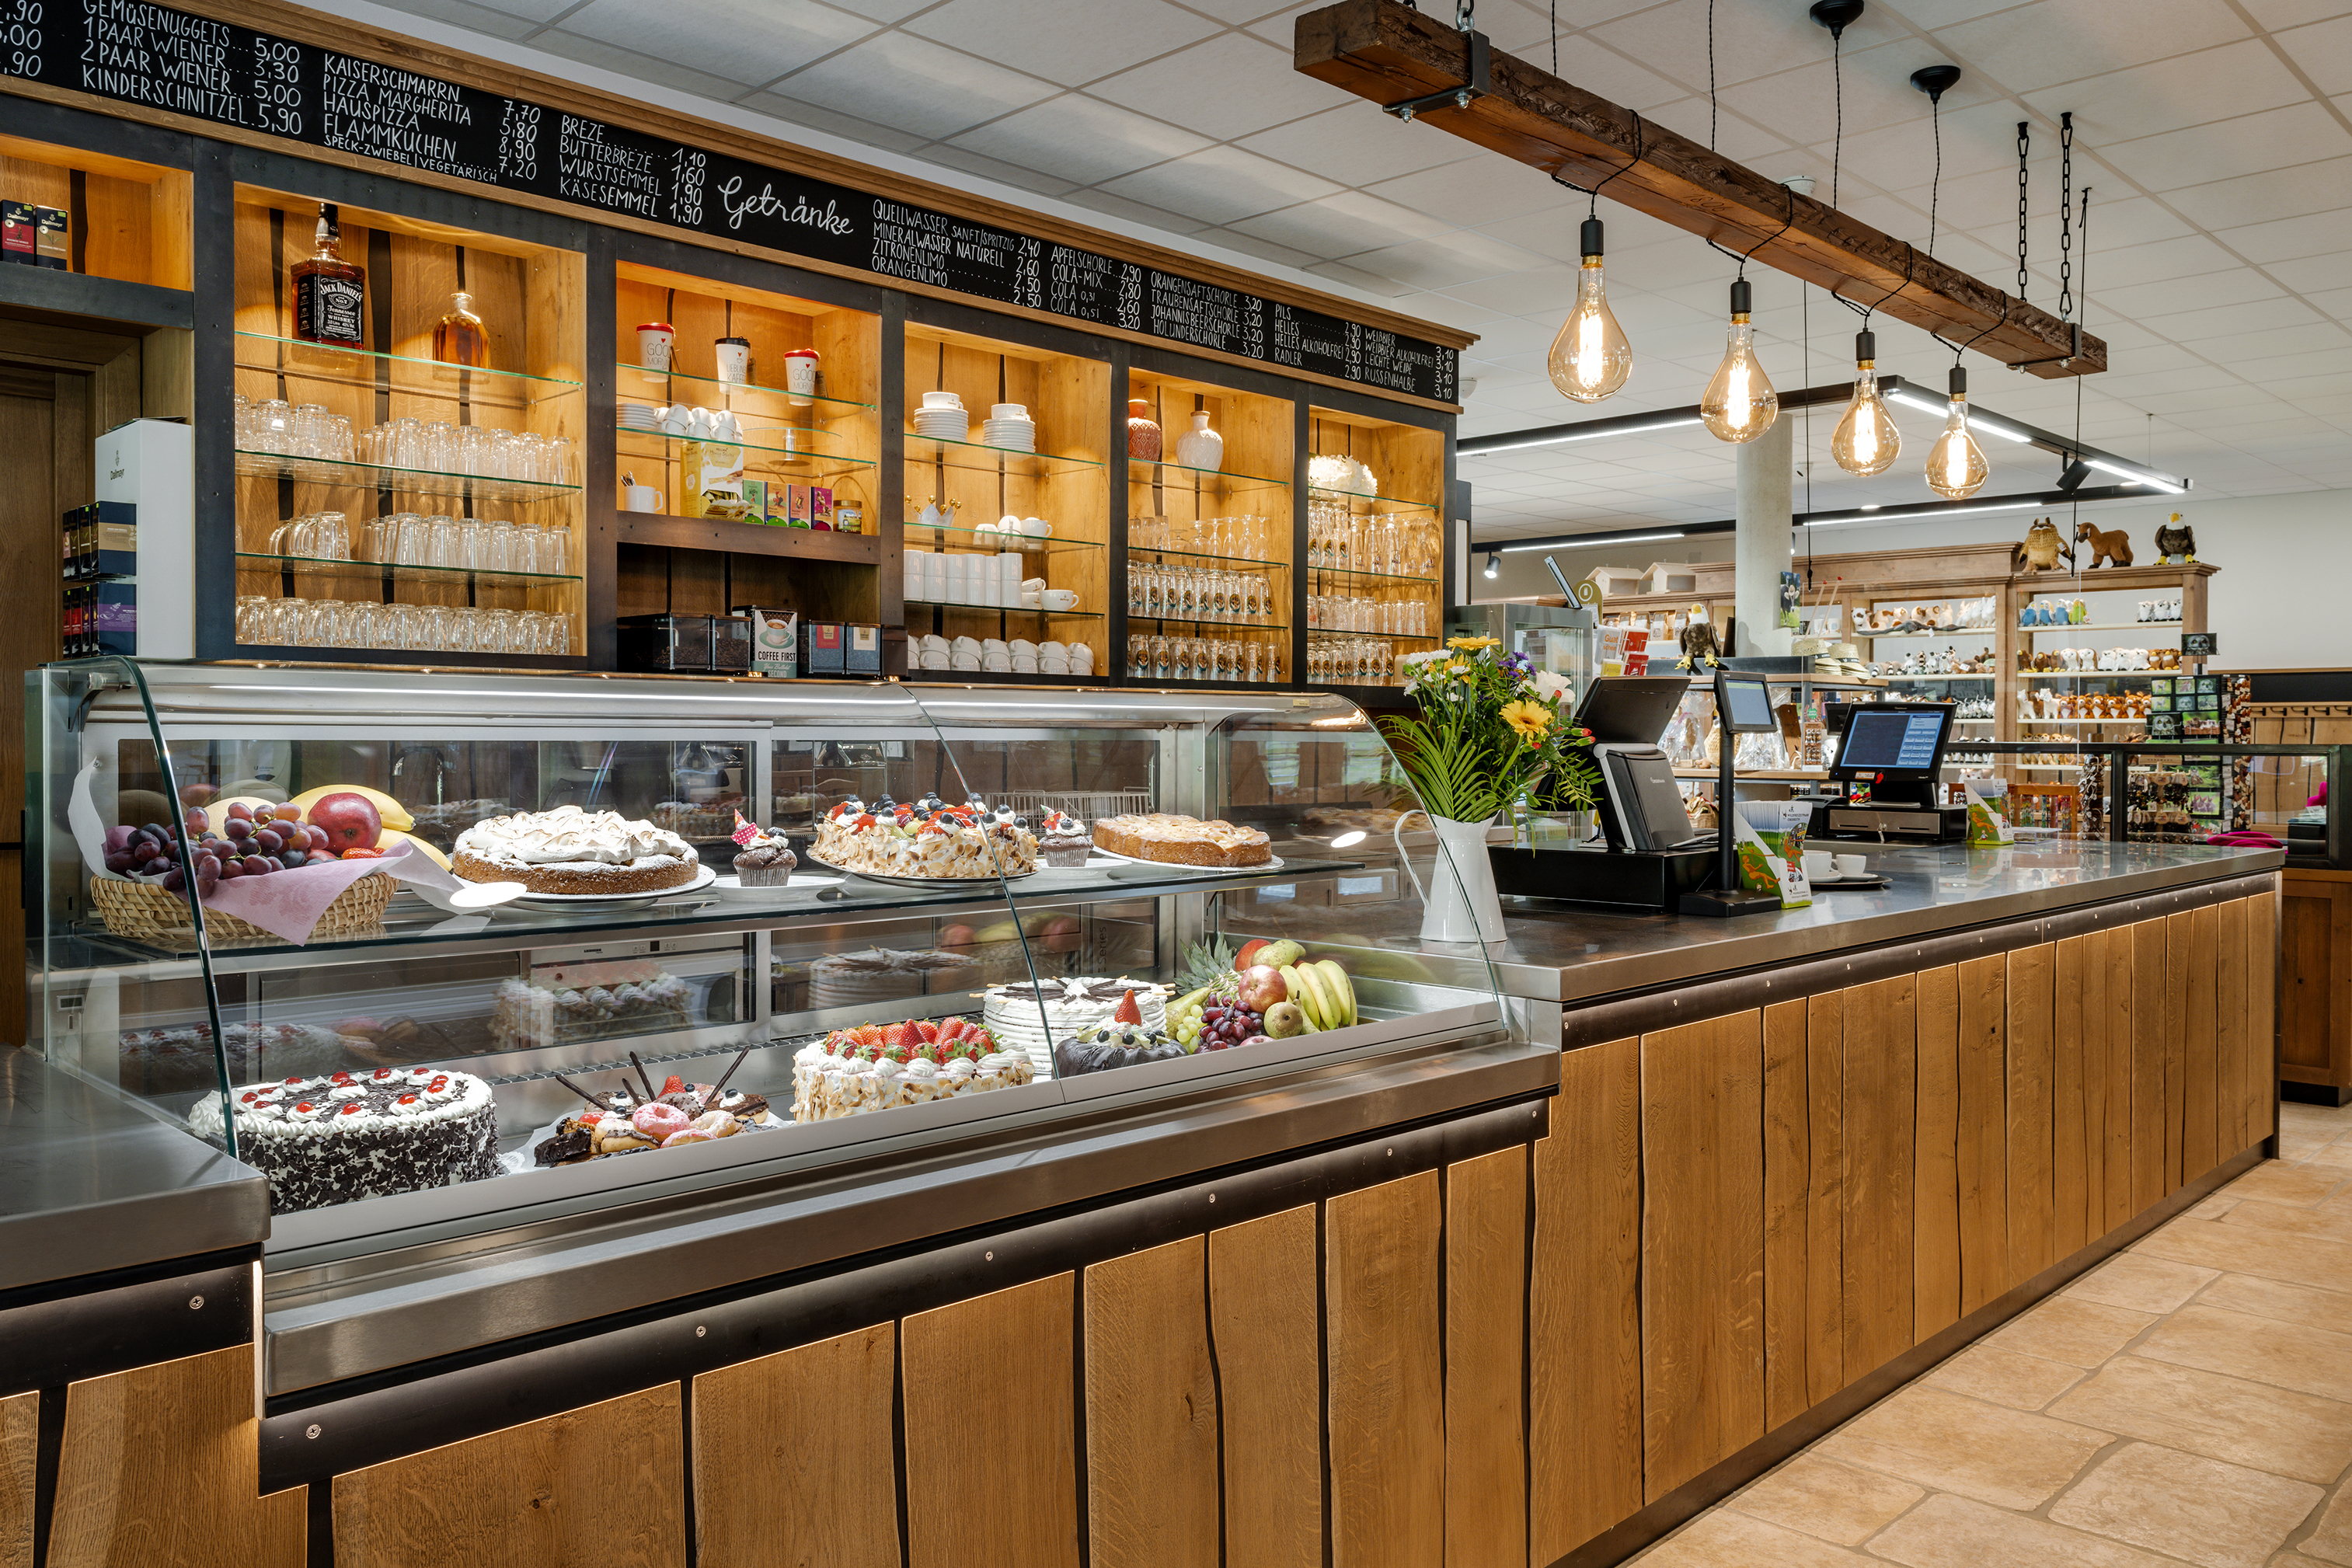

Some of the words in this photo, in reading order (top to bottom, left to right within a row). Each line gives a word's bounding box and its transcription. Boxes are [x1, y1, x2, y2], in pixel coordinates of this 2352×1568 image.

[0, 0, 42, 24] ,90
[0, 51, 41, 77] ,90
[151, 32, 226, 68] WIENER
[254, 58, 299, 83] 3,30
[254, 37, 300, 63] 5,00
[82, 64, 249, 124] KINDERSCHNITZEL
[258, 103, 302, 134] 5,90
[159, 55, 231, 95] WIENER
[254, 80, 301, 106] 5,00
[325, 54, 460, 102] KAISERSCHMARRN
[504, 100, 540, 124] 7,70
[323, 74, 369, 101] PIZZA
[378, 88, 472, 126] MARGHERITA
[500, 118, 538, 142] 5,80
[324, 92, 420, 131] HAUSPIZZA
[499, 137, 535, 161] 8,90
[324, 114, 456, 162] FLAMMKUCHEN
[499, 156, 537, 180] 7,20
[562, 115, 605, 144] BREZE
[672, 148, 706, 167] 1,10
[559, 134, 653, 173] BUTTERBREZE
[671, 165, 705, 186] 1,60
[559, 155, 661, 196] WURSTSEMMEL
[671, 182, 702, 206] 1,90
[7, 213, 30, 221] Dallmayr
[560, 176, 657, 218] KÄSESEMMEL
[670, 203, 702, 225] 1,90
[717, 176, 853, 235] Getränke
[41, 219, 63, 228] Dallmayr
[873, 199, 948, 235] QUELLWASSER
[1018, 237, 1040, 257] 2,40
[873, 222, 951, 255] MINERALWASSER
[956, 242, 1005, 268] NATURELL
[1016, 256, 1040, 277] 2,60
[873, 237, 945, 270] ZITRONENLIMO
[1013, 274, 1040, 293] 2,50
[1051, 246, 1113, 274] APFELSCHORLE
[1120, 263, 1141, 283] 2,90
[320, 284, 337, 294] JACK
[872, 255, 948, 287] ORANGENLIMO
[1013, 290, 1042, 308] 2,50
[1051, 280, 1076, 300] COLA
[1117, 297, 1140, 315] 2,60
[1052, 263, 1103, 288] COLA-MIX
[1119, 280, 1141, 300] 2,80
[328, 315, 355, 323] WHISKEY
[1050, 295, 1076, 315] COLA
[1118, 312, 1141, 330] 3,20
[1152, 289, 1239, 324] TRAUBENSAFTSCHORLE
[1242, 312, 1263, 328] 3,20
[1244, 296, 1263, 312] 3,20
[1275, 303, 1291, 321] PILS
[1345, 322, 1361, 338] 2,90
[1151, 305, 1240, 339] JOHANNISBEERSCHORLE
[1242, 326, 1263, 343] 3,20
[1153, 319, 1226, 350] HOLUNDERSCHORLE
[1242, 341, 1264, 358] 3,20
[1274, 319, 1300, 336] HELLES
[1345, 333, 1361, 350] 2,90
[1274, 332, 1300, 350] HELLES
[1301, 339, 1343, 360] ALKOHOLFREI
[1345, 347, 1361, 364] 2,90
[1274, 347, 1302, 366] RADLER
[1345, 364, 1361, 381] 2,90
[1396, 349, 1434, 368] ALKOHOLFREI
[1435, 358, 1454, 373] 3,10
[1435, 346, 1454, 361] 3,10
[1364, 352, 1390, 369] LEICHTE
[1434, 371, 1453, 385] 3,10
[1364, 366, 1416, 393] RUSSENHALBE
[1434, 384, 1452, 399] 3,10
[110, 469, 124, 480] Dallmayr
[758, 650, 779, 660] COFFEE
[781, 652, 796, 661] FIRST
[1098, 926, 1106, 964] Series
